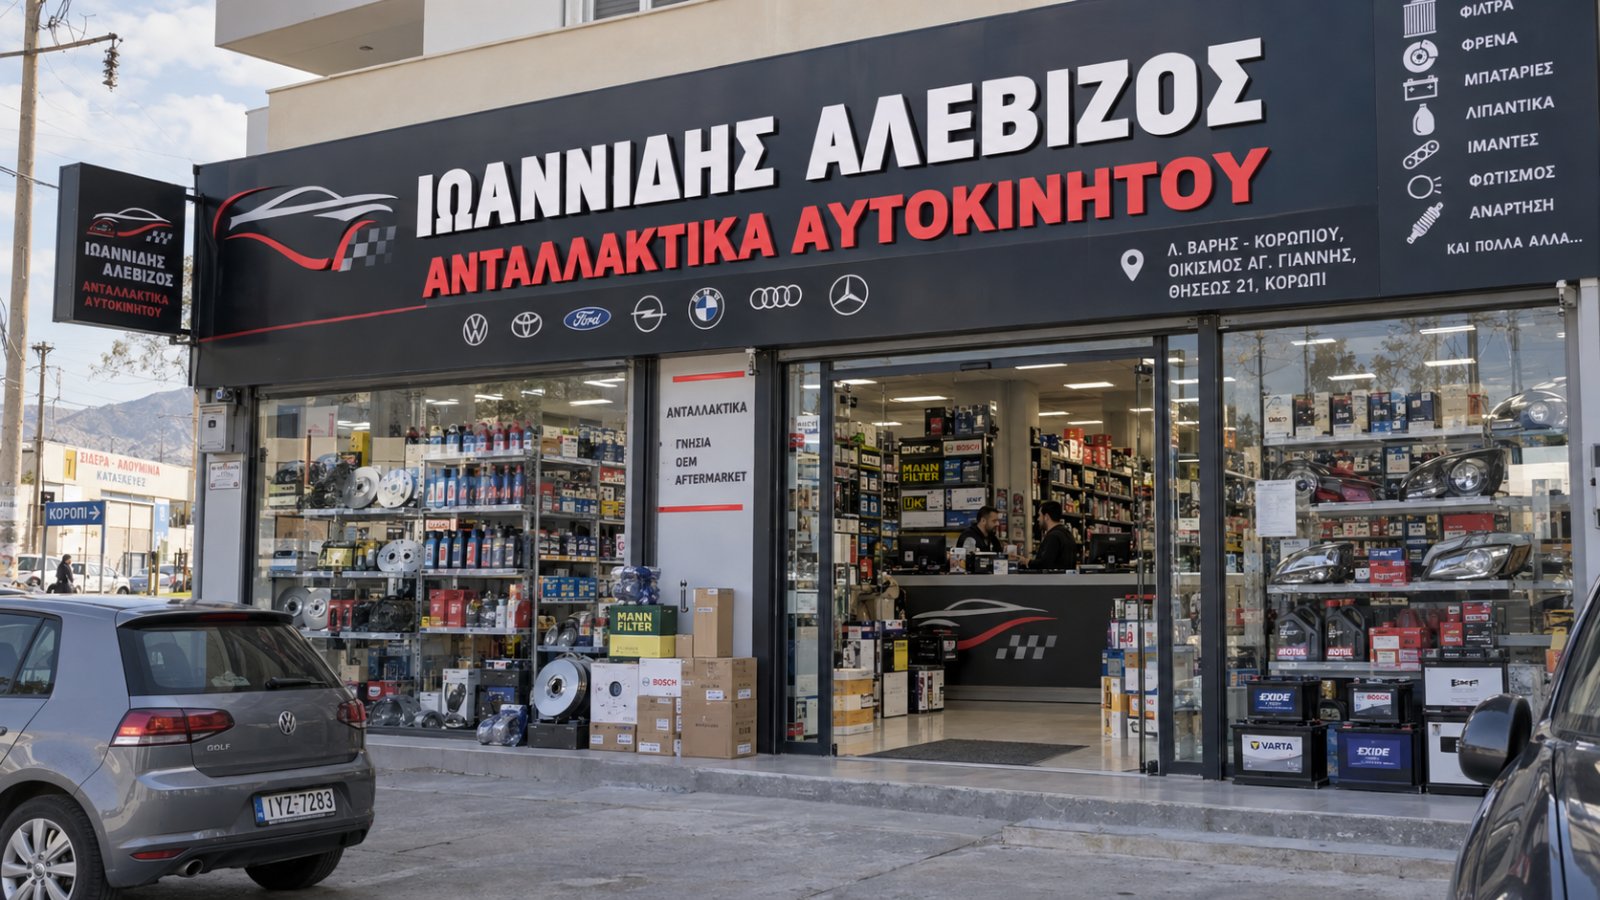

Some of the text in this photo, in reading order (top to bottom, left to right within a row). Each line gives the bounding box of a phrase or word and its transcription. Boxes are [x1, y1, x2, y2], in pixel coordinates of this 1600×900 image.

[1460, 0, 1514, 18] ΦΙΛΤΡΑ
[1461, 31, 1518, 51] ΦΡΕΝΑ
[1464, 61, 1553, 86] ΜΠΑΤΑΡΙΕΣ
[1465, 95, 1555, 120] ΛΙΠΑΝΤΙΚΑ
[416, 37, 1263, 238] ΙΩΑΝΝΙΔΗΣ ΑΛΕΒΙΖΟΣ
[1467, 132, 1539, 154] ΙΜΑΝΤΕΣ
[1469, 165, 1556, 187] ΦΩΤΙΣΜΟΣ
[1469, 198, 1554, 219] ΑΝΑΡΤΗΣΗ
[422, 147, 1269, 298] ΑΝΤΑΛΛΑΚΤΙΚΑ ΑΥΤΟΚΙΝΗΤΟΥ
[1167, 242, 1182, 257] Λ.
[1188, 236, 1239, 255] ΒΑΡΗΣ
[1254, 226, 1344, 249] ΚΟΡΩΠΙΟΥ,
[1447, 242, 1469, 255] ΚΑΙ
[1475, 237, 1523, 253] ΠΟΛΛΑ
[84, 241, 166, 269] ΙΩΑΝΝΙΔΗΣ
[1168, 247, 1357, 278] ΟΙΚΙΣΜΟΣ ΑΓ. ΓΙΑΝΝΗΣ,
[102, 262, 174, 287] ΑΛΕΒΙΖΟΣ
[82, 281, 169, 305] ΑΝΤΑΛΛΑΚΤΙΚΑ
[1168, 271, 1327, 299] ΘΗΣΕΩΣ 21, ΚΟΡΩΠΙ
[84, 296, 162, 318] ΑΥΤΟΚΙΝΗΤΟΥ
[573, 310, 602, 327] Ford
[666, 401, 748, 419] ΑΝΤΑΛΛΑΚΤΙΚΑ
[675, 437, 711, 450] ΓΝΗΣΙΑ
[80, 452, 109, 467] ΣΙΔΕΡΑ
[675, 457, 697, 468] OEM
[902, 463, 939, 473] MANN
[675, 471, 747, 486] AFTERMARKET
[902, 472, 939, 482] FILTER
[49, 507, 87, 520] ΚΟΡΟΠΙ
[617, 612, 652, 622] MANN
[617, 622, 652, 632] FILTER
[1278, 648, 1306, 656] MOTUL
[1327, 648, 1353, 656] MOTUL
[652, 678, 677, 687] BOSCH
[1259, 692, 1291, 702] EXIDE
[206, 743, 231, 752] GOLF
[1261, 741, 1293, 751] VARTA
[1356, 747, 1390, 757] EXIDE
